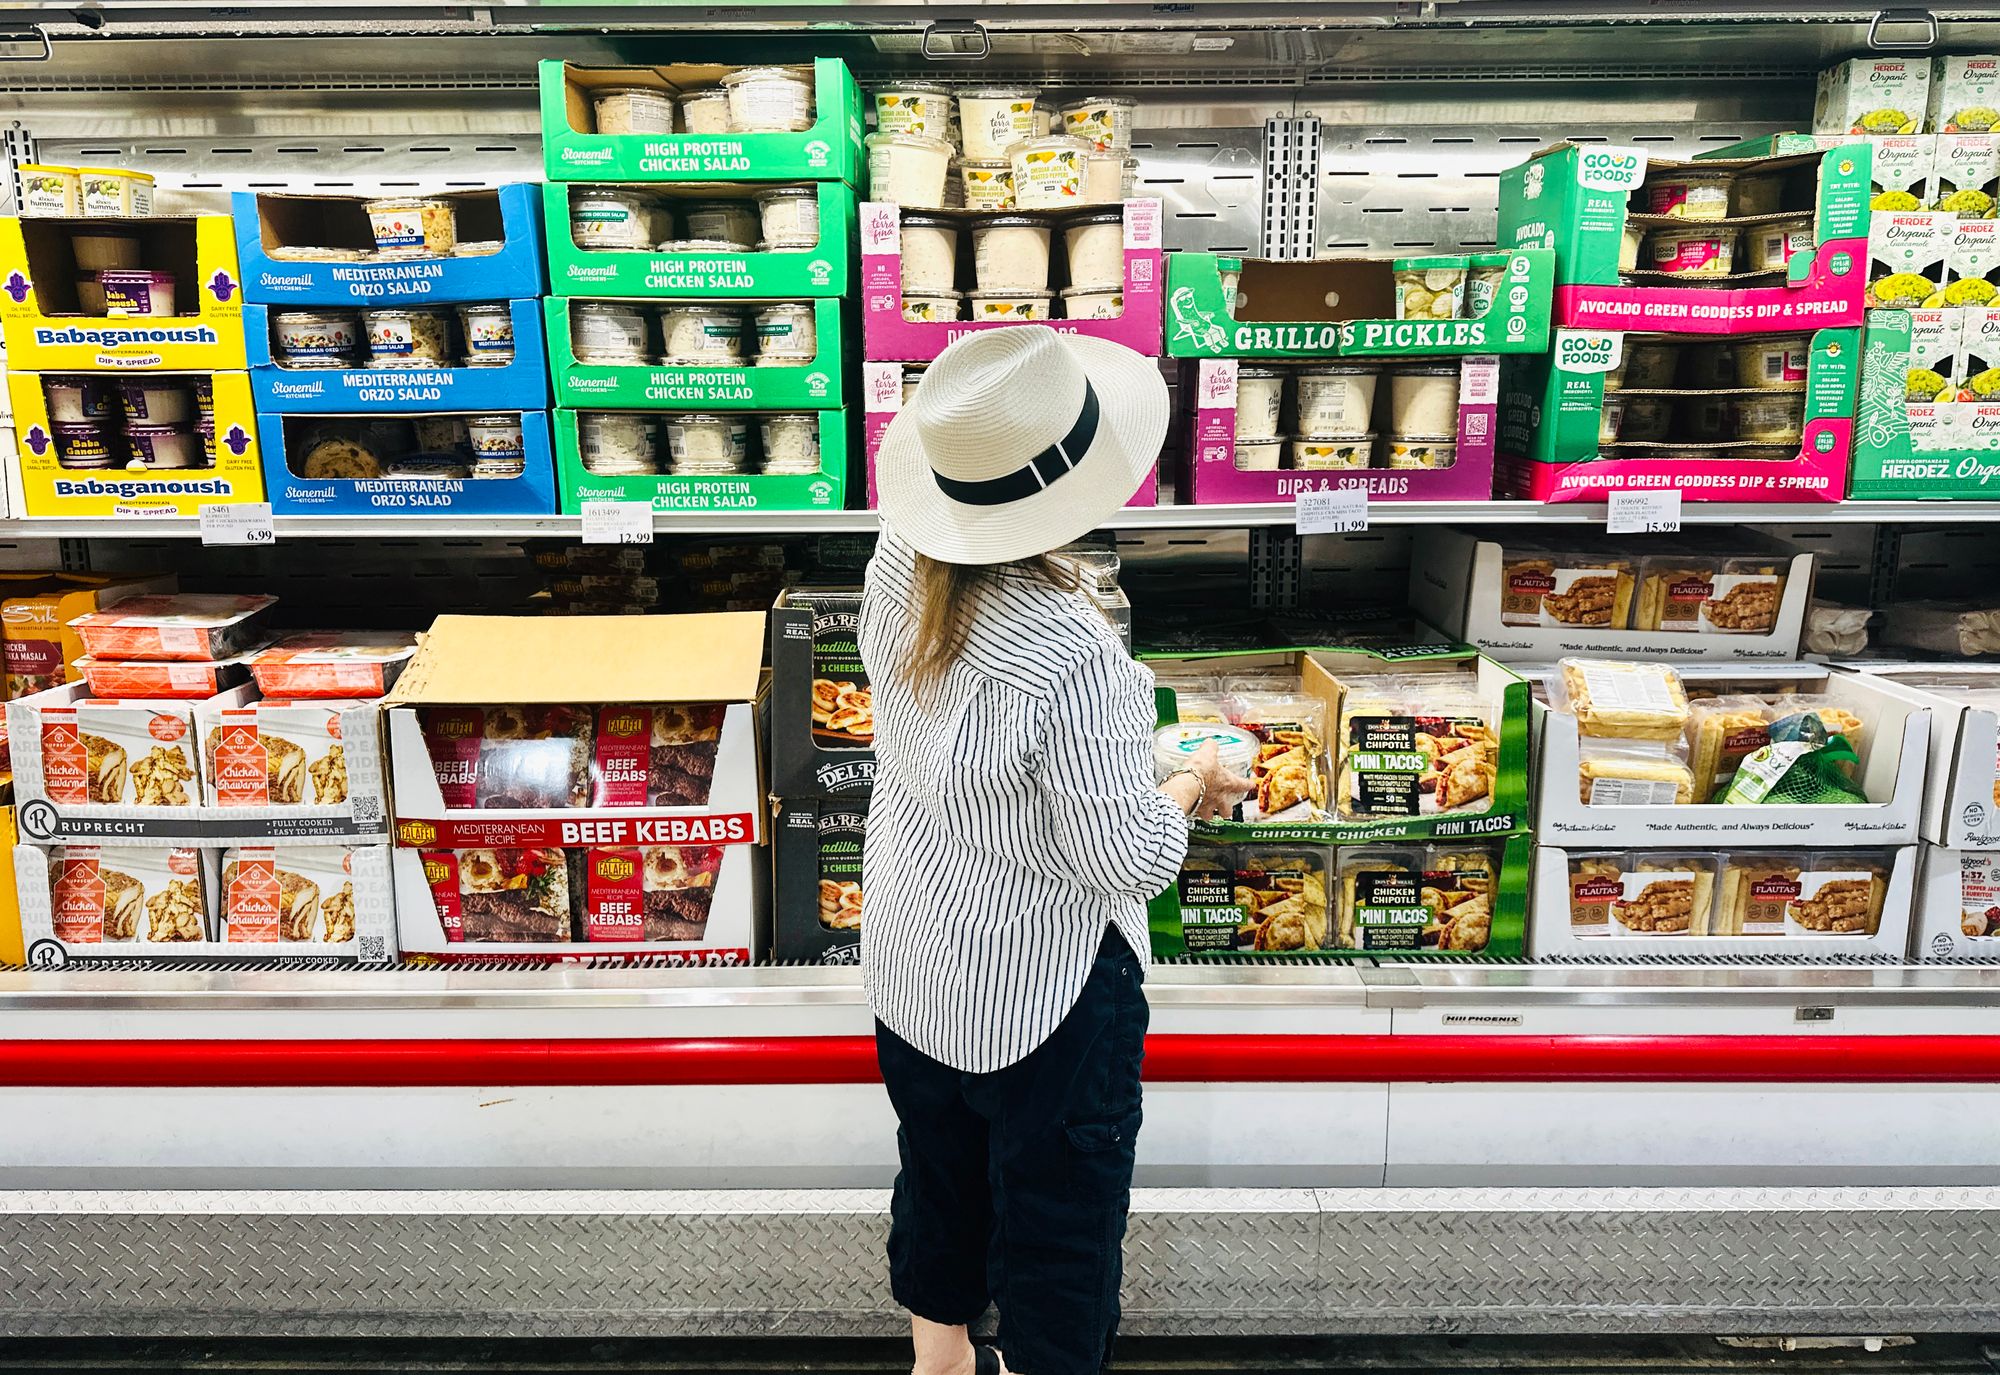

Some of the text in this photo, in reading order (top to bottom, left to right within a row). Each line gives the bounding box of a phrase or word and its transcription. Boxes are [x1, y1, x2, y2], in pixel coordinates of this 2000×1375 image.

[1873, 64, 1905, 72] HERDEZ
[1967, 60, 1996, 69] HERDEZ
[1870, 71, 1907, 82] Organic
[1963, 69, 1998, 81] Organic
[1882, 139, 1917, 147] HERDEZ
[1956, 138, 1991, 147] HERDEZ
[561, 146, 613, 160] Stonemill
[644, 142, 742, 156] HIGH PROTEIN
[1878, 148, 1919, 161] Organic
[1952, 147, 1992, 160] Organic
[639, 157, 750, 172] CHICKEN SALAD
[1584, 153, 1637, 169] GOOD
[1585, 169, 1633, 183] FOODS
[30, 200, 64, 209] hummus
[88, 203, 121, 212] hummus
[1587, 199, 1613, 208] REAL
[1892, 217, 1932, 226] HERDEZ
[1886, 225, 1935, 239] Organic
[1959, 224, 1994, 232] HERDEZ
[1955, 231, 1997, 245] Organic
[567, 263, 618, 277] Stonemill
[650, 260, 746, 274] HIGH PROTEIN
[1515, 259, 1526, 272] 5
[260, 272, 315, 286] Stonemill
[332, 264, 443, 282] MEDITERRANEAN
[645, 275, 754, 288] CHICKEN SALAD
[349, 280, 431, 296] ORZO SALAD
[1511, 292, 1526, 300] GF
[1578, 300, 1848, 319] AVOCADO GREEN GODDESS DIP & SPREAD
[36, 328, 217, 348] Babaganoush
[1234, 323, 1485, 350] GRILLO'S PICKLES
[1561, 337, 1613, 351] GOOD
[98, 356, 161, 366] DIP SPREAD
[1562, 352, 1610, 365] FOODS
[342, 373, 453, 387] MEDITERRANEAN
[567, 375, 618, 388] Stonemill
[650, 372, 746, 386] HIGH PROTEIN
[1566, 381, 1591, 389] REAL
[271, 381, 325, 394] Stonemill
[645, 387, 753, 399] CHICKEN SALAD
[359, 387, 441, 401] ORZO SALAD
[1881, 464, 1950, 479] HERDEZ
[354, 480, 464, 493] MEDITERRANEAN
[656, 482, 750, 494] HIGH PROTEIN
[1277, 477, 1409, 495] DIPS SPREADS
[1561, 475, 1829, 489] AVOCADO GREEN GODDESS DIP & SPREAD
[56, 481, 231, 497] Babaganoush
[285, 486, 337, 499] Stonemill
[576, 486, 626, 498] Stonemill
[371, 493, 452, 507] ORZO SALAD
[652, 496, 757, 508] CHICKEN SALAD
[1303, 498, 1330, 506] 327081
[1617, 498, 1649, 506] 1896992
[143, 507, 177, 516] SPREAD
[1334, 521, 1365, 532] 11.99
[1646, 522, 1677, 532] 15.99
[247, 530, 272, 541] 6.99
[620, 533, 650, 543] 12.99
[1513, 579, 1550, 587] FLAUTAS
[1673, 587, 1709, 595] FLAUTAS
[814, 615, 838, 633] DEL
[1559, 643, 1583, 651] "Made
[1585, 644, 1624, 653] Authentic,
[1642, 645, 1669, 655] Always
[1670, 647, 1708, 655] Delicious"
[20, 652, 47, 661] MASALA
[821, 664, 865, 673] 3 CHEESES
[1365, 741, 1411, 749] CHIPOTLE
[606, 759, 637, 769] BEEF
[1353, 754, 1425, 770] MINI TACOS
[44, 764, 79, 775] Chicken
[224, 766, 259, 778] Chicken
[817, 764, 859, 788] DEL
[218, 779, 265, 790] Shawarma
[61, 821, 145, 833] RUPRECHT
[299, 819, 333, 827] COOKED
[1435, 816, 1512, 835] MINI TACOS
[1645, 822, 1815, 833] "Made Authentic, and Always Delicious"
[308, 827, 345, 835] PREPARE
[400, 823, 545, 842] FALAFEL MEDITERRANEAN
[561, 818, 745, 844] BEEF KEBABS
[1251, 826, 1407, 840] CHIPOTLE CHICKEN
[484, 835, 517, 845] RECIPE
[1964, 832, 2000, 845] Realgood
[598, 865, 632, 875] FALAFEL
[1187, 887, 1228, 895] CHICKEN
[1373, 888, 1415, 896] CHICKEN
[1579, 886, 1619, 896] FLAUTAS
[1755, 884, 1796, 895] FLAUTAS
[1186, 895, 1230, 903] CHIPOTLE
[1372, 896, 1417, 904] CHIPOTLE
[62, 900, 96, 911] Chicken
[237, 901, 272, 912] Chicken
[600, 902, 632, 913] BEEF
[54, 914, 101, 924] Shawarma
[229, 914, 278, 925] Shawarma
[590, 914, 643, 925] KEBABS
[1203, 907, 1243, 924] TACOS
[1359, 908, 1429, 924] MINI TACOS
